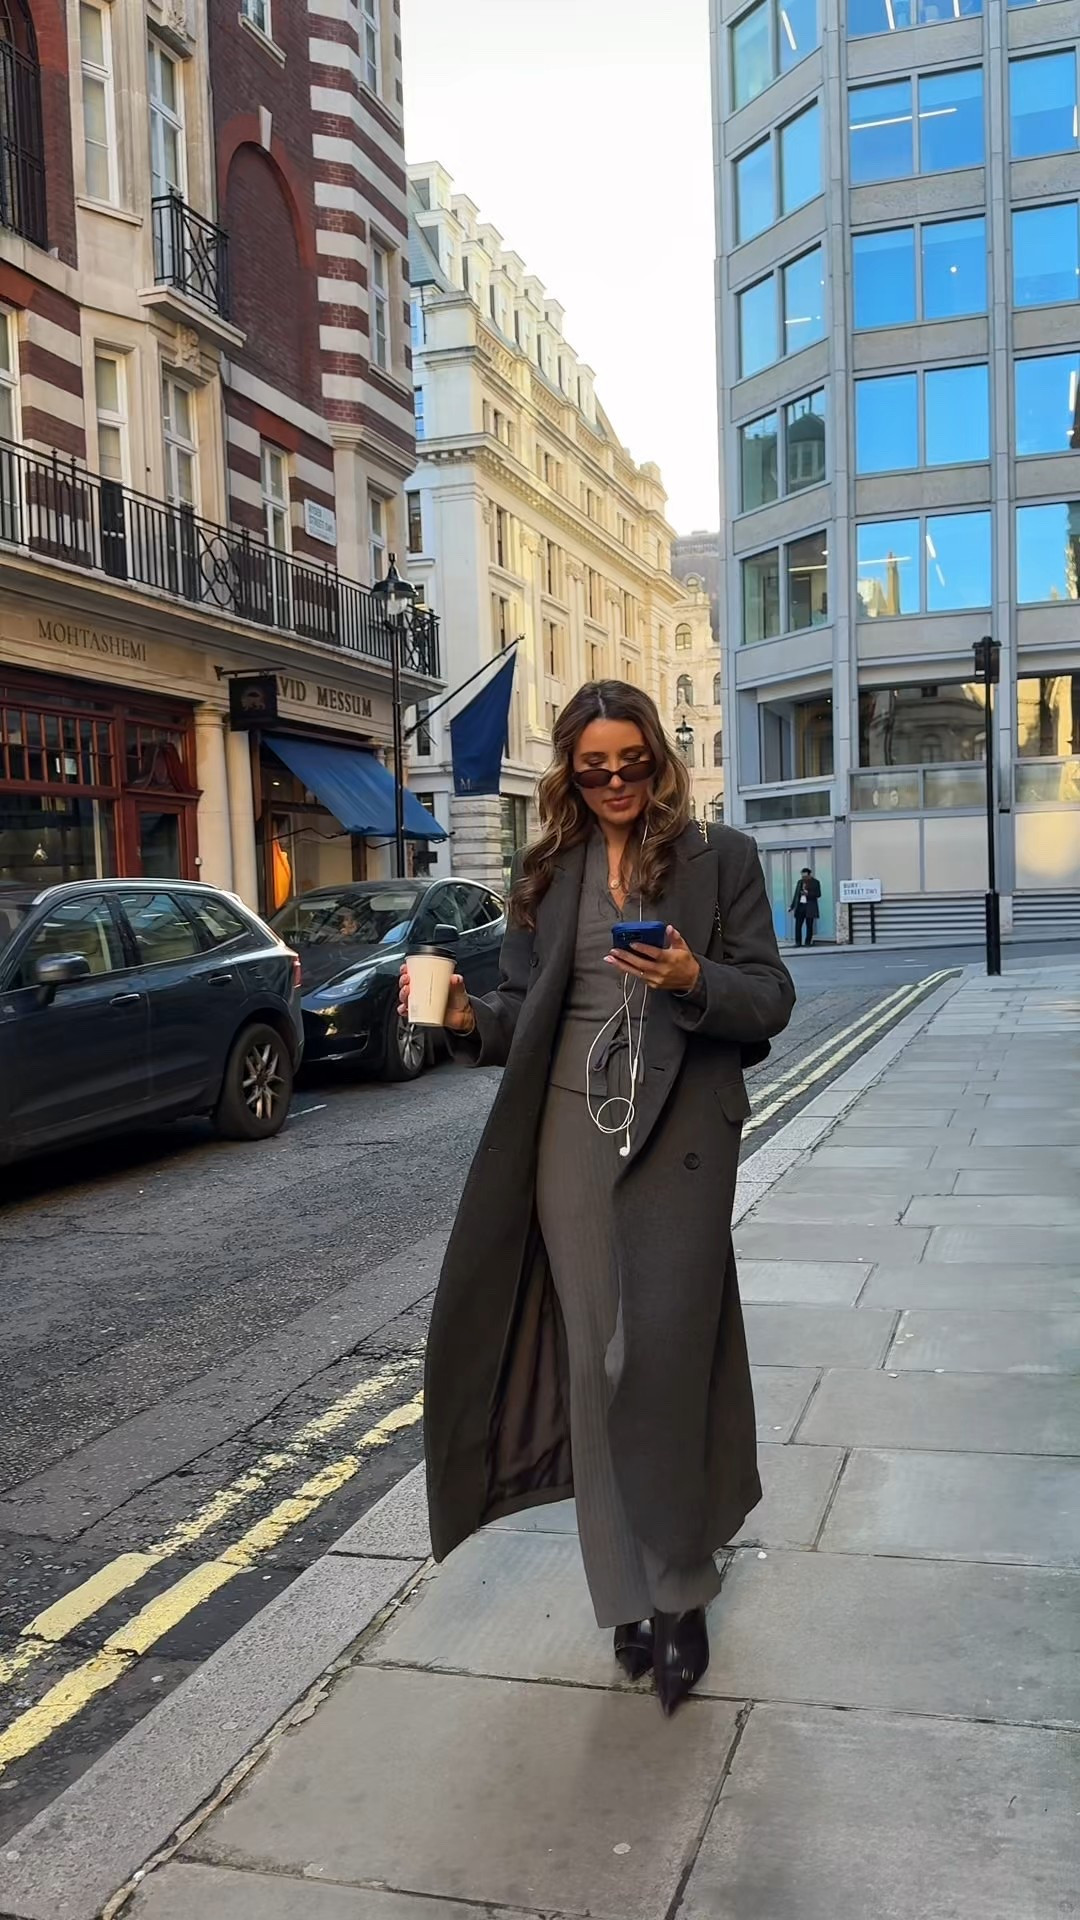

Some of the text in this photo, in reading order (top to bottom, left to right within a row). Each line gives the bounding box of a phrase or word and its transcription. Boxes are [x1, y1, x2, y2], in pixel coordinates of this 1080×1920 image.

[38, 618, 146, 661] MOHTASHEMI
[276, 676, 372, 717] VID MESSUM
[844, 888, 864, 896] STREET
